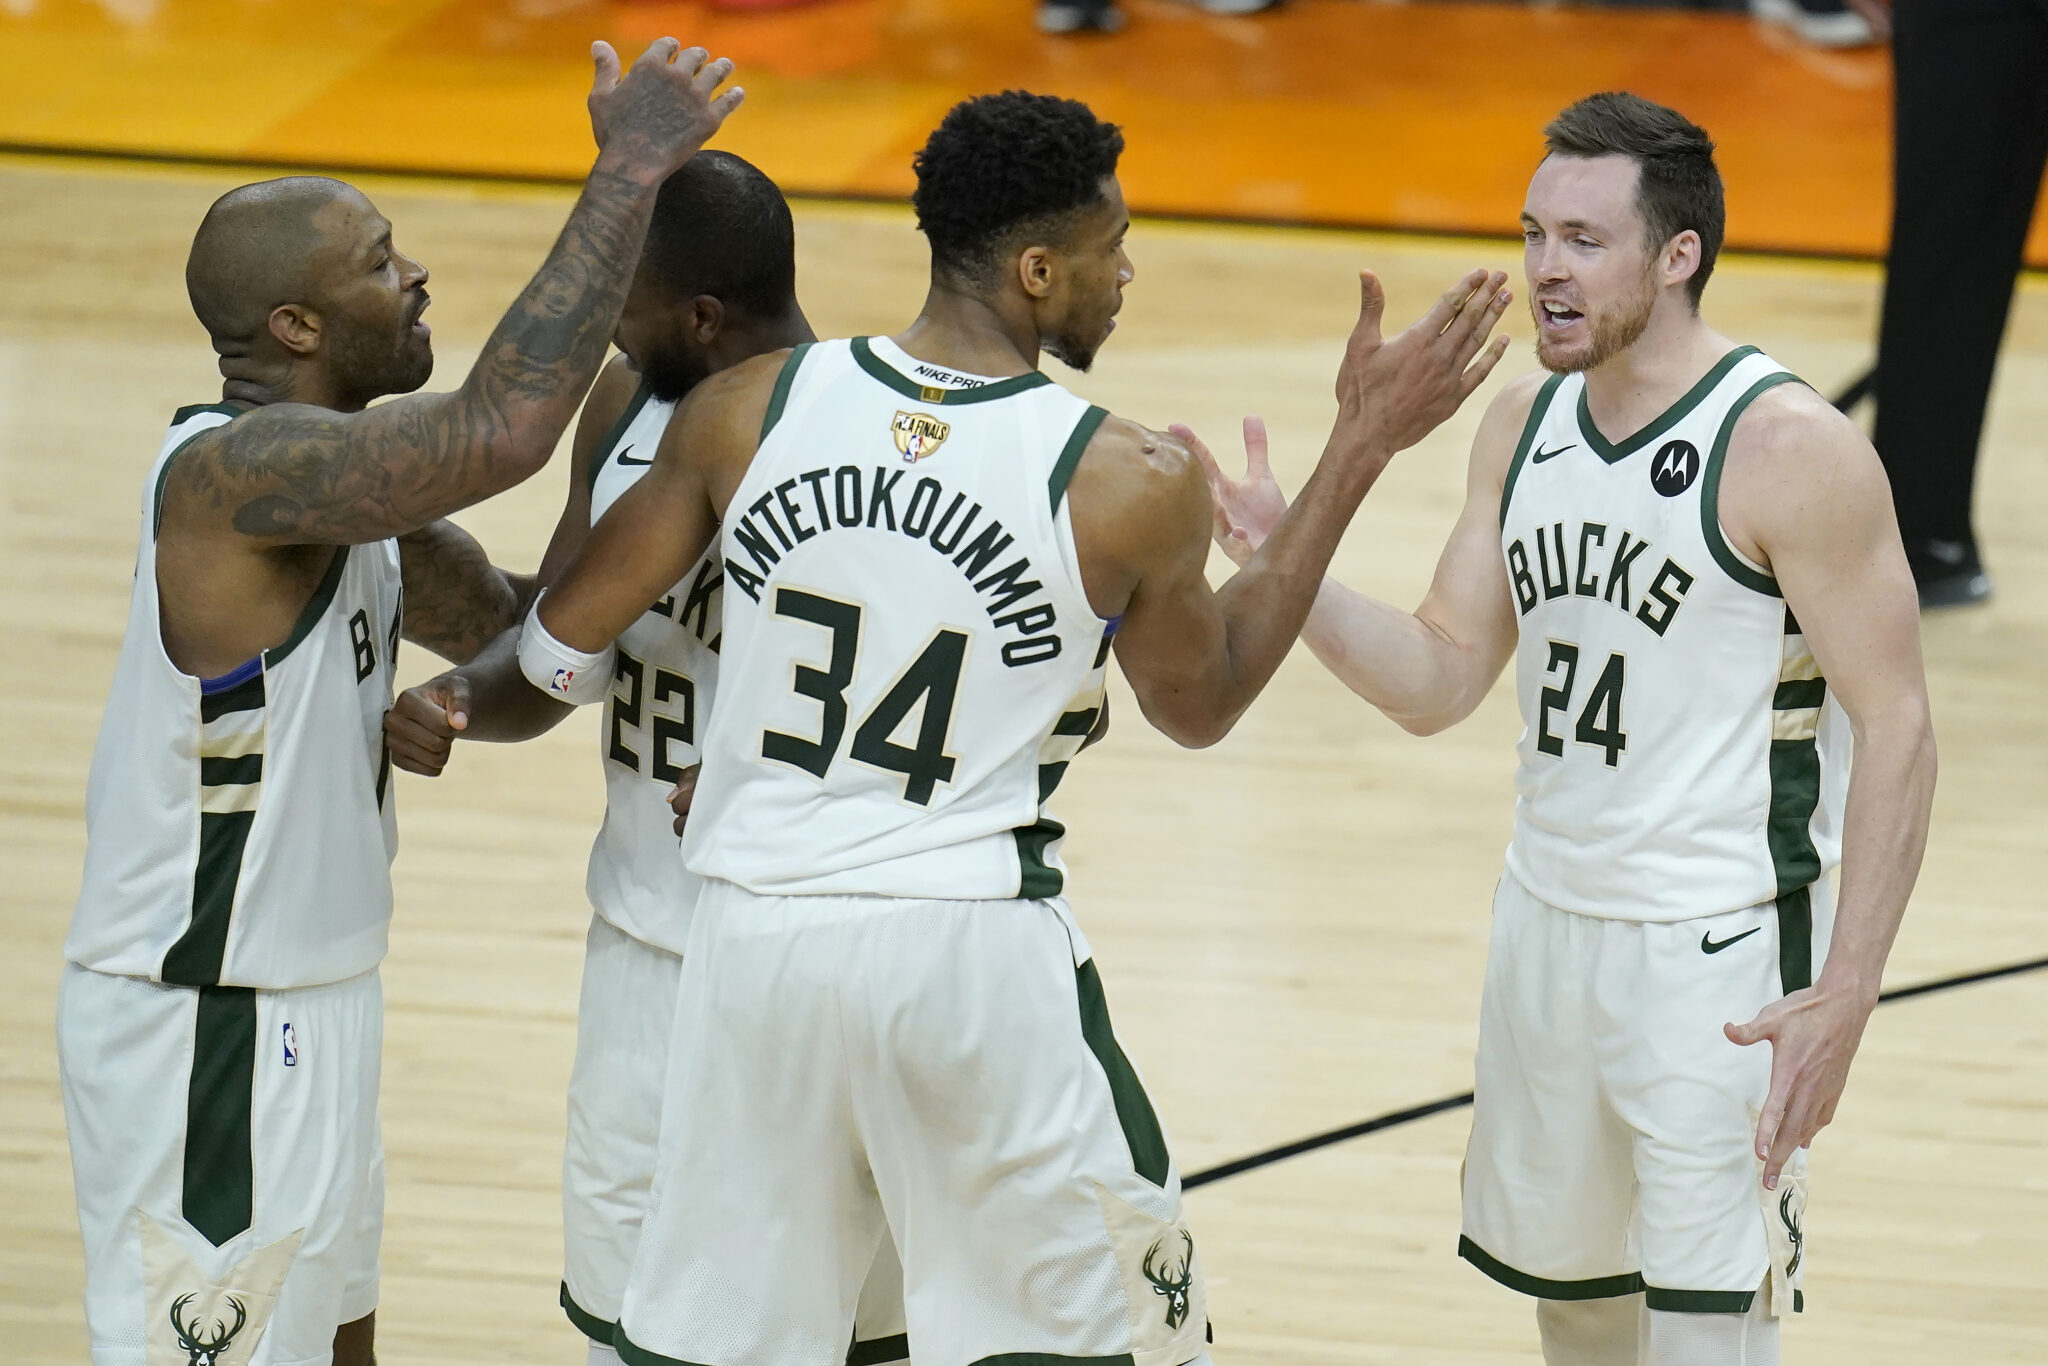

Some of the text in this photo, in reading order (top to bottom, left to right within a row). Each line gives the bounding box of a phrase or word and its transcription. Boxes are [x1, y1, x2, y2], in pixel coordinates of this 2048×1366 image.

[914, 365, 951, 382] NIKE
[914, 419, 947, 441] FINALS
[725, 465, 1062, 668] ANTETOKOUNMPO
[1507, 519, 1698, 640] BUCKS
[608, 645, 698, 787] 22
[758, 582, 974, 811] 34
[1536, 637, 1629, 771] 24
